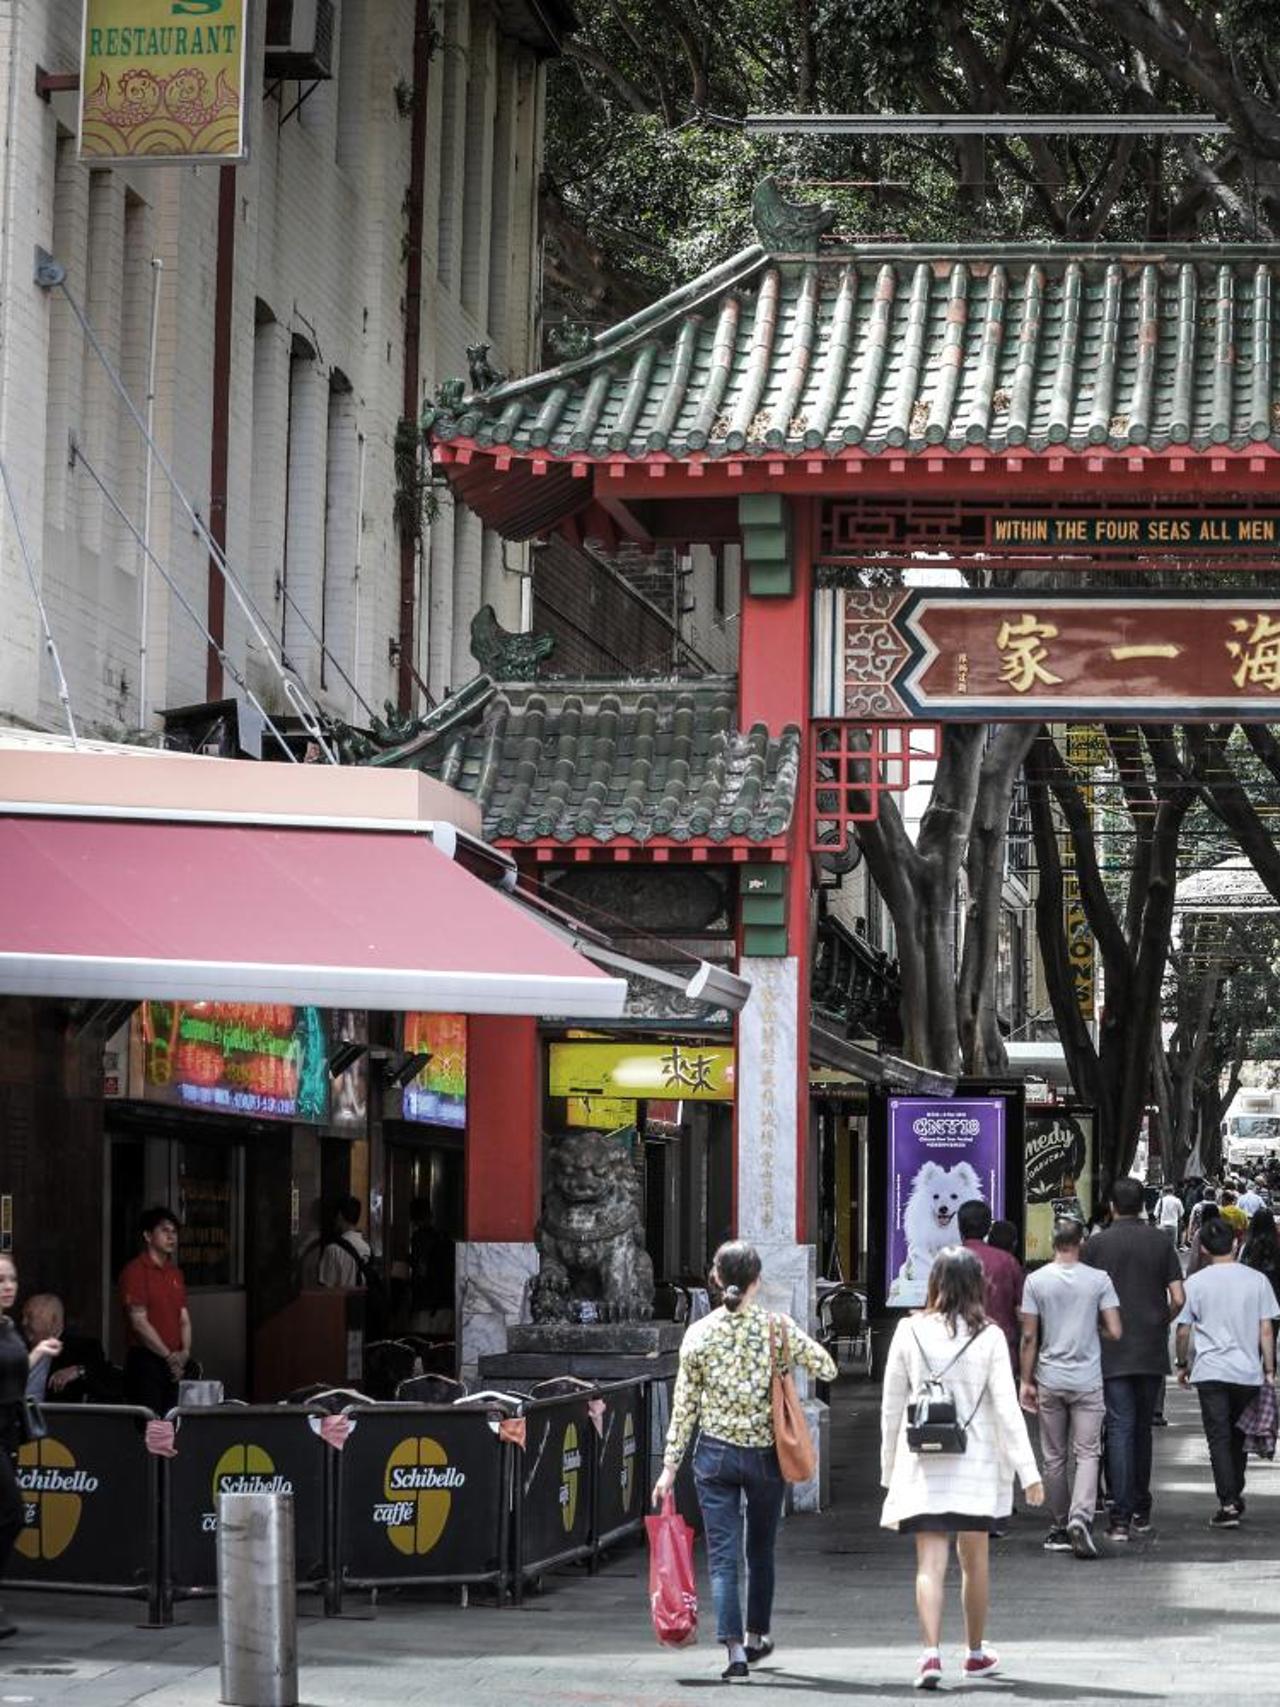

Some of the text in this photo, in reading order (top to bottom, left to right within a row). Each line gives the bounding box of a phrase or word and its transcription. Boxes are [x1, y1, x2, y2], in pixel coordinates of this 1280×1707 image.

[89, 25, 236, 57] RESTAURANT
[995, 520, 1047, 541] WITHIN
[1055, 520, 1087, 540] THE
[1095, 520, 1139, 540] FOUR
[1148, 520, 1191, 540] SEAS
[1199, 520, 1231, 540] ALL
[1238, 520, 1274, 540] MEN
[1025, 1121, 1074, 1160] medy
[220, 1474, 294, 1494] Schibello
[391, 1467, 465, 1489] Schibello
